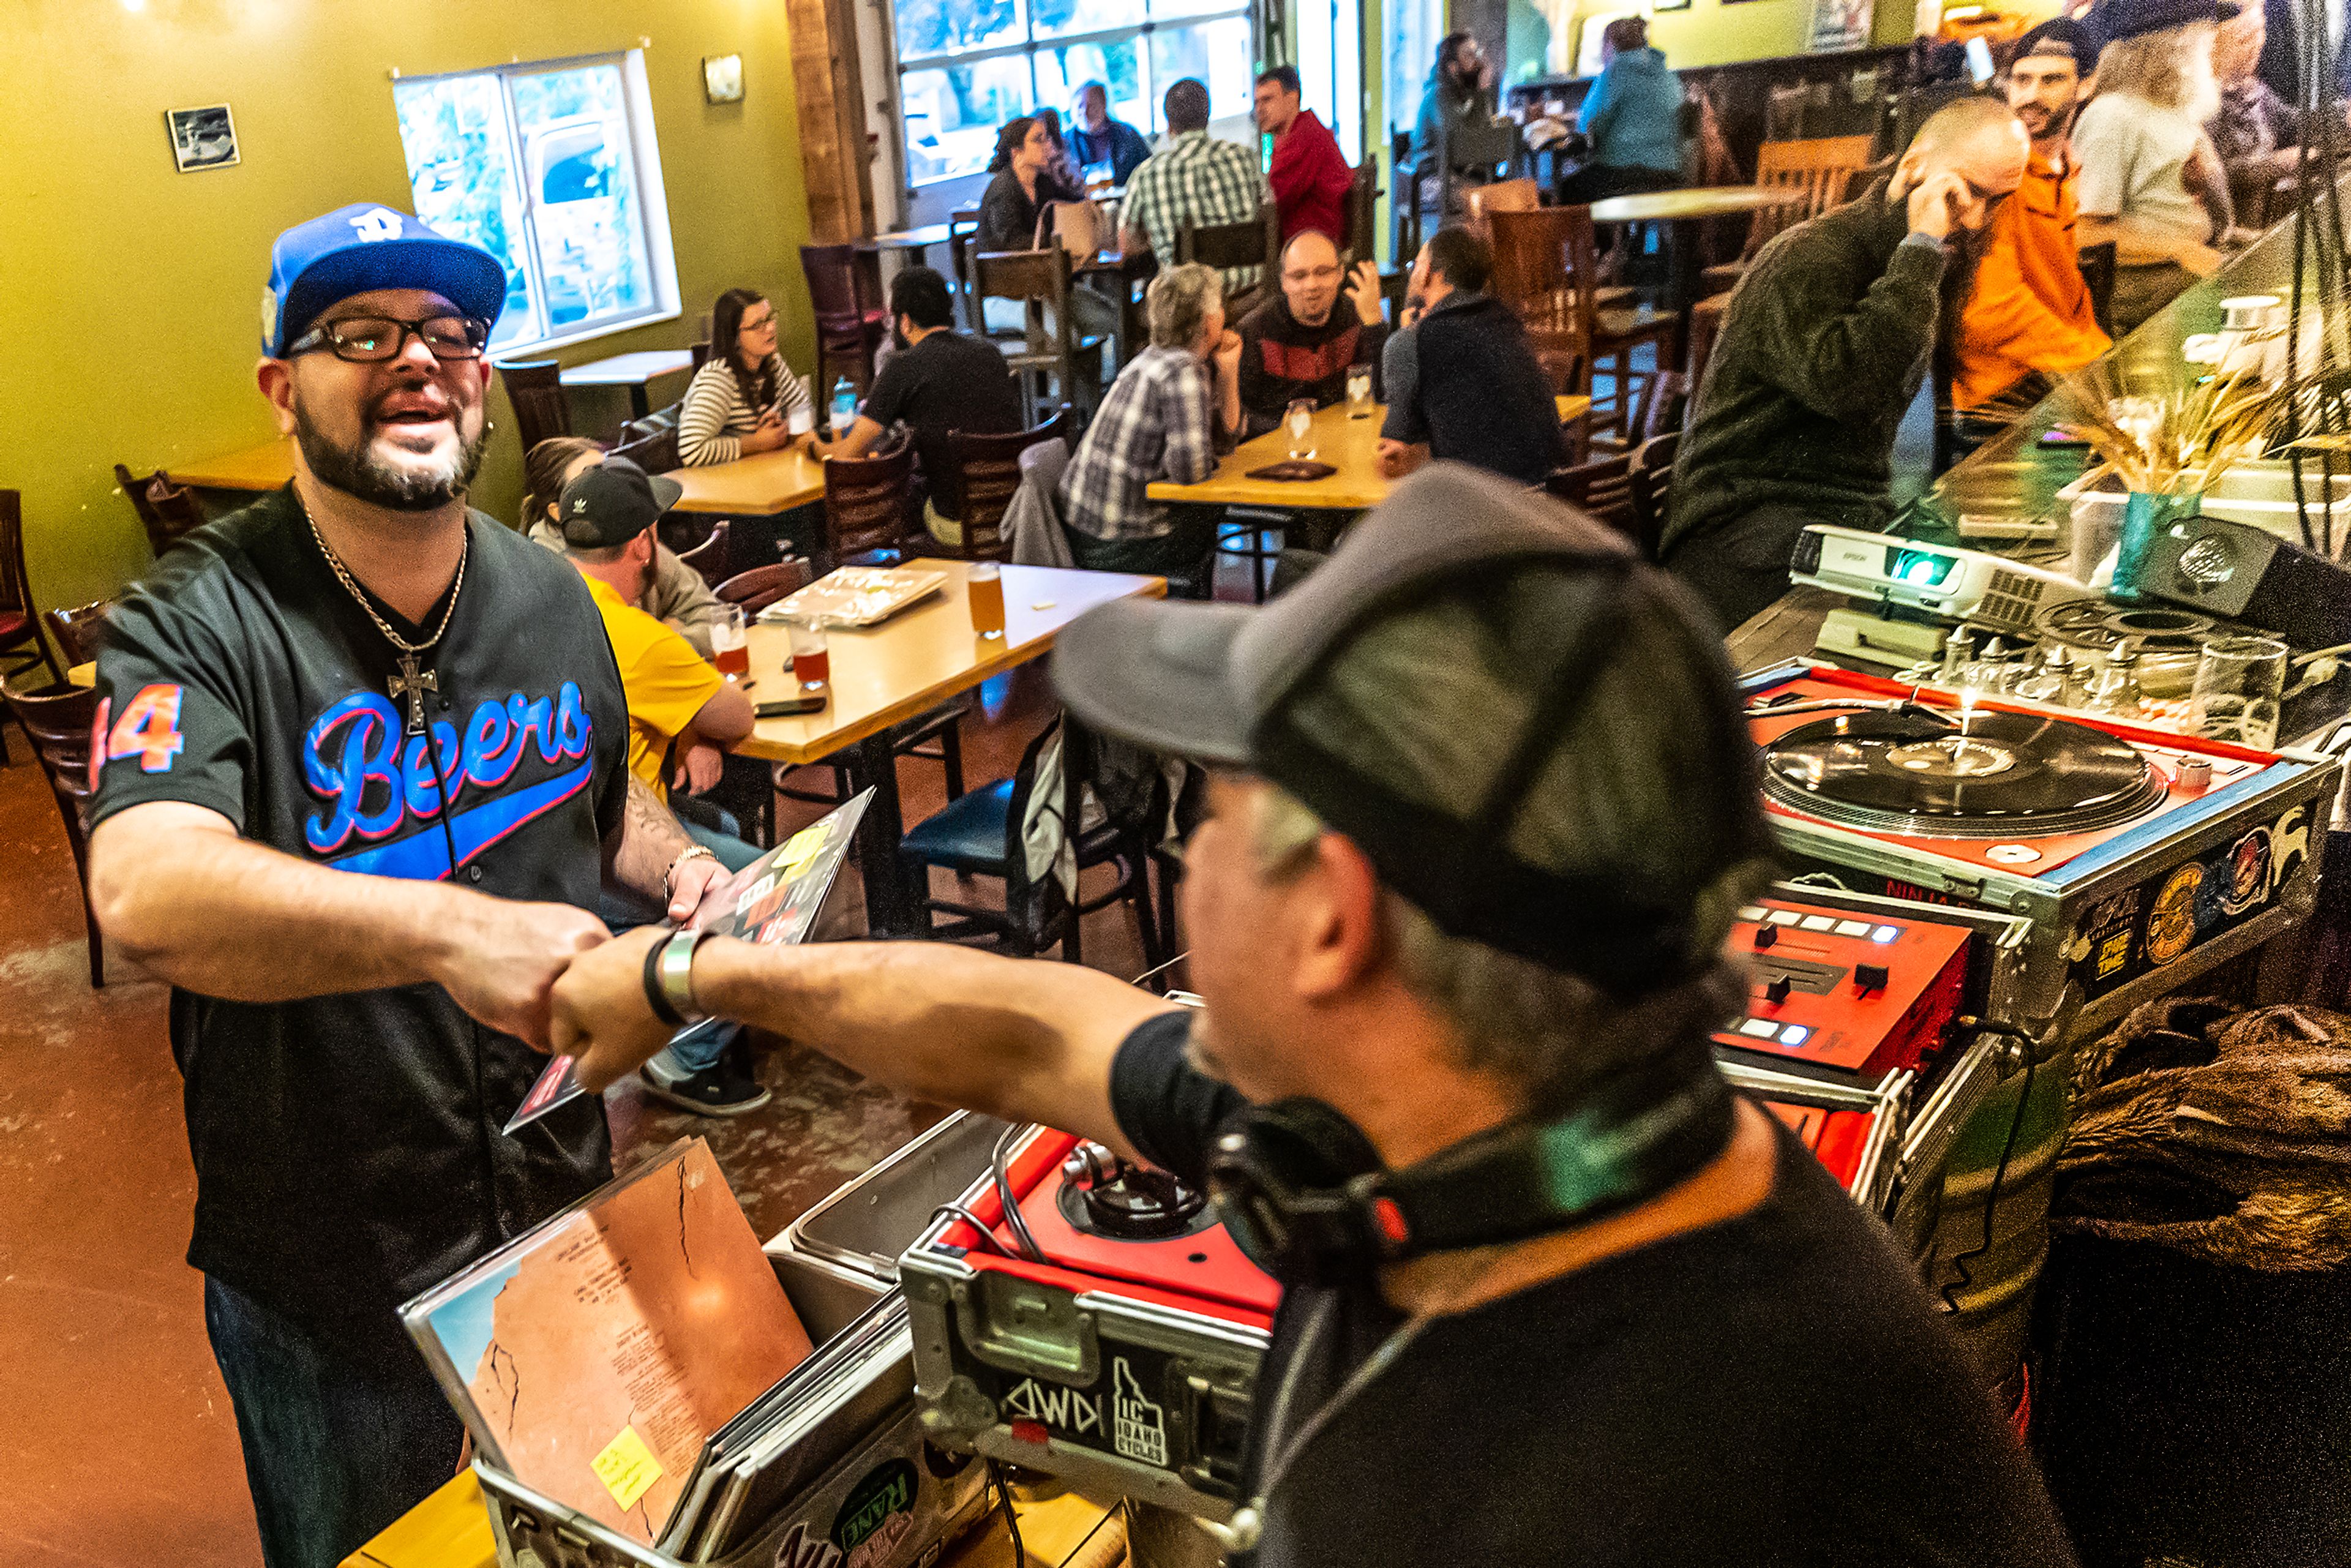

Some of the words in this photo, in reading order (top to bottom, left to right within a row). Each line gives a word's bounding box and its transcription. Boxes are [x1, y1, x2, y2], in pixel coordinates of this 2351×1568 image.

[304, 680, 591, 853] Beers
[1122, 1397, 1143, 1423] IC
[1117, 1420, 1162, 1450] IDAHO
